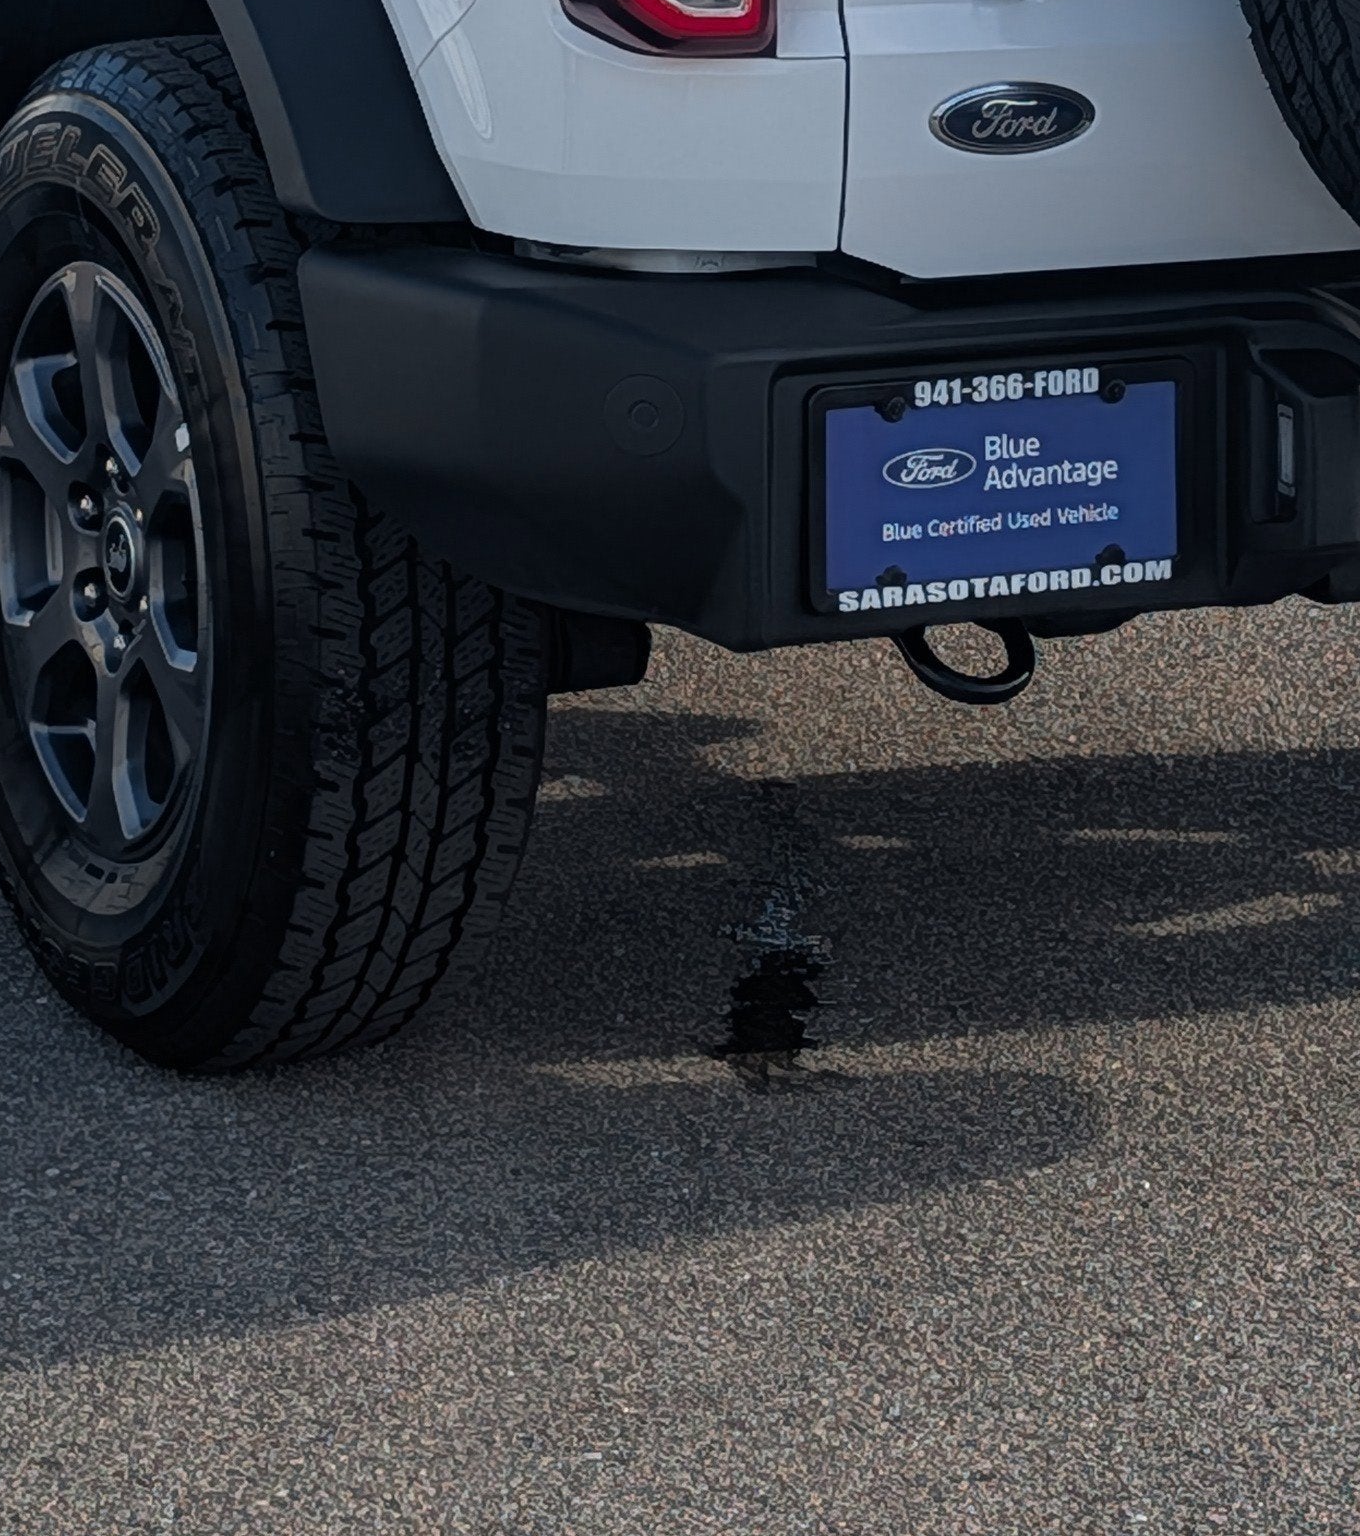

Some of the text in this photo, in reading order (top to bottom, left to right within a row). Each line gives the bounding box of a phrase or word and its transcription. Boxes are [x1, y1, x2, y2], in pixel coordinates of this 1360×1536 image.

[972, 99, 1057, 139] Ford
[914, 367, 1099, 408] 941-366-FORD
[984, 434, 1040, 461] Blue
[901, 454, 957, 483] Ford
[983, 458, 1118, 491] Advantage
[883, 503, 1119, 542] Blue Certified Used Vehicle
[839, 559, 1172, 613] SARASOTAFORD.COM
